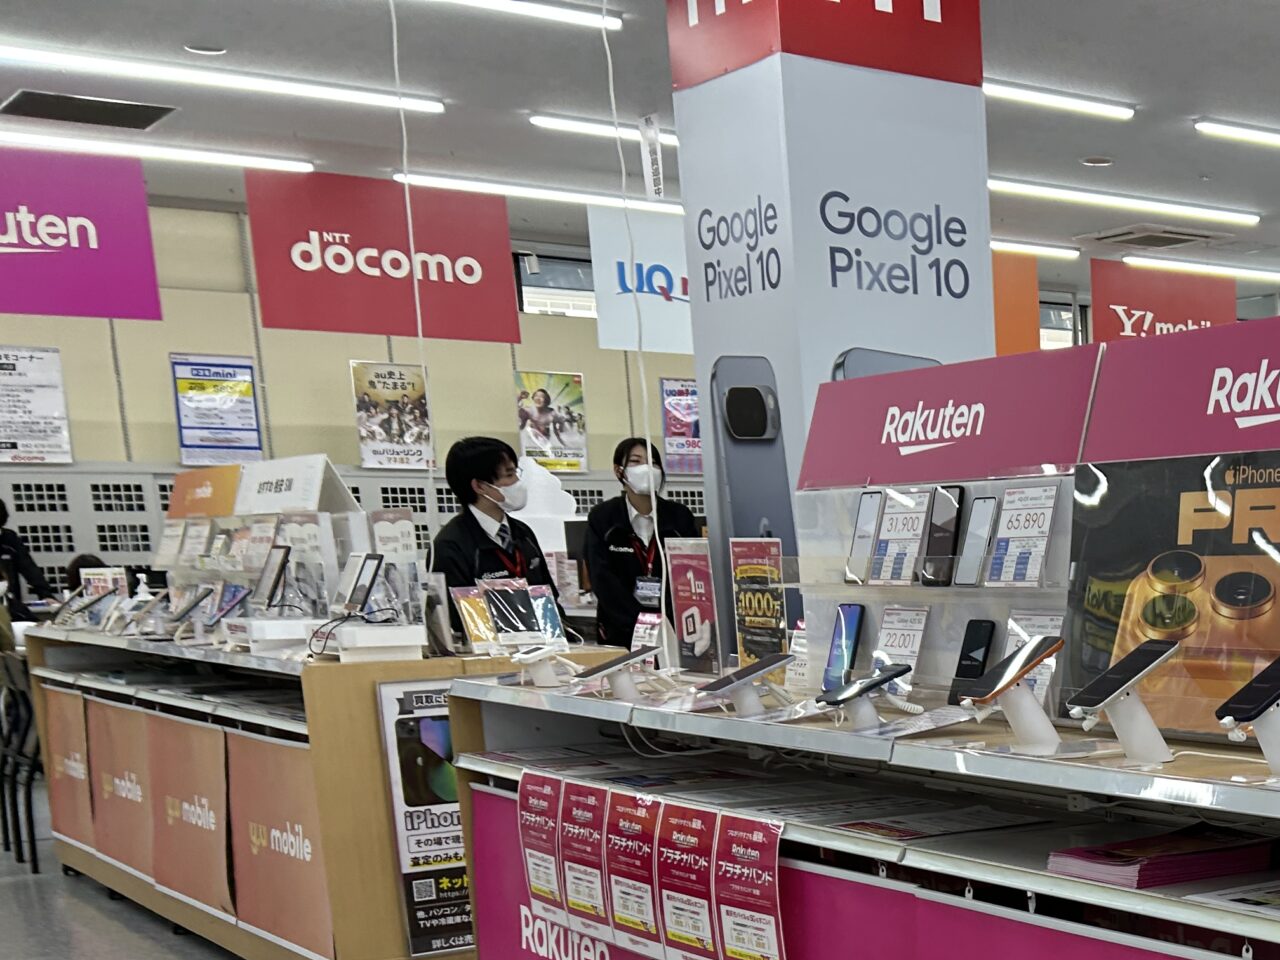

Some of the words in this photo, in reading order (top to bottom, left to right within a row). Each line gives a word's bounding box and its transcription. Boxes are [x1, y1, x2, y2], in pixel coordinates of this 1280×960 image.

[323, 232, 350, 244] NTT
[698, 196, 778, 252] Google
[819, 191, 968, 256] Google
[290, 231, 483, 285] docomo
[703, 253, 751, 302] Pixel
[757, 247, 781, 291] 10
[829, 247, 918, 296] Pixel
[928, 258, 970, 300] 10
[617, 261, 673, 302] UQ
[881, 400, 986, 446] Rakuten
[886, 516, 920, 533] 31,900
[1006, 512, 1046, 531] 65,890
[884, 632, 916, 649] 22,001
[182, 795, 216, 830] mobile
[270, 821, 312, 862] mobile
[608, 834, 651, 858] プラチナバンド
[659, 847, 709, 871] プラチナバンド
[718, 860, 774, 886] プラチナバンド
